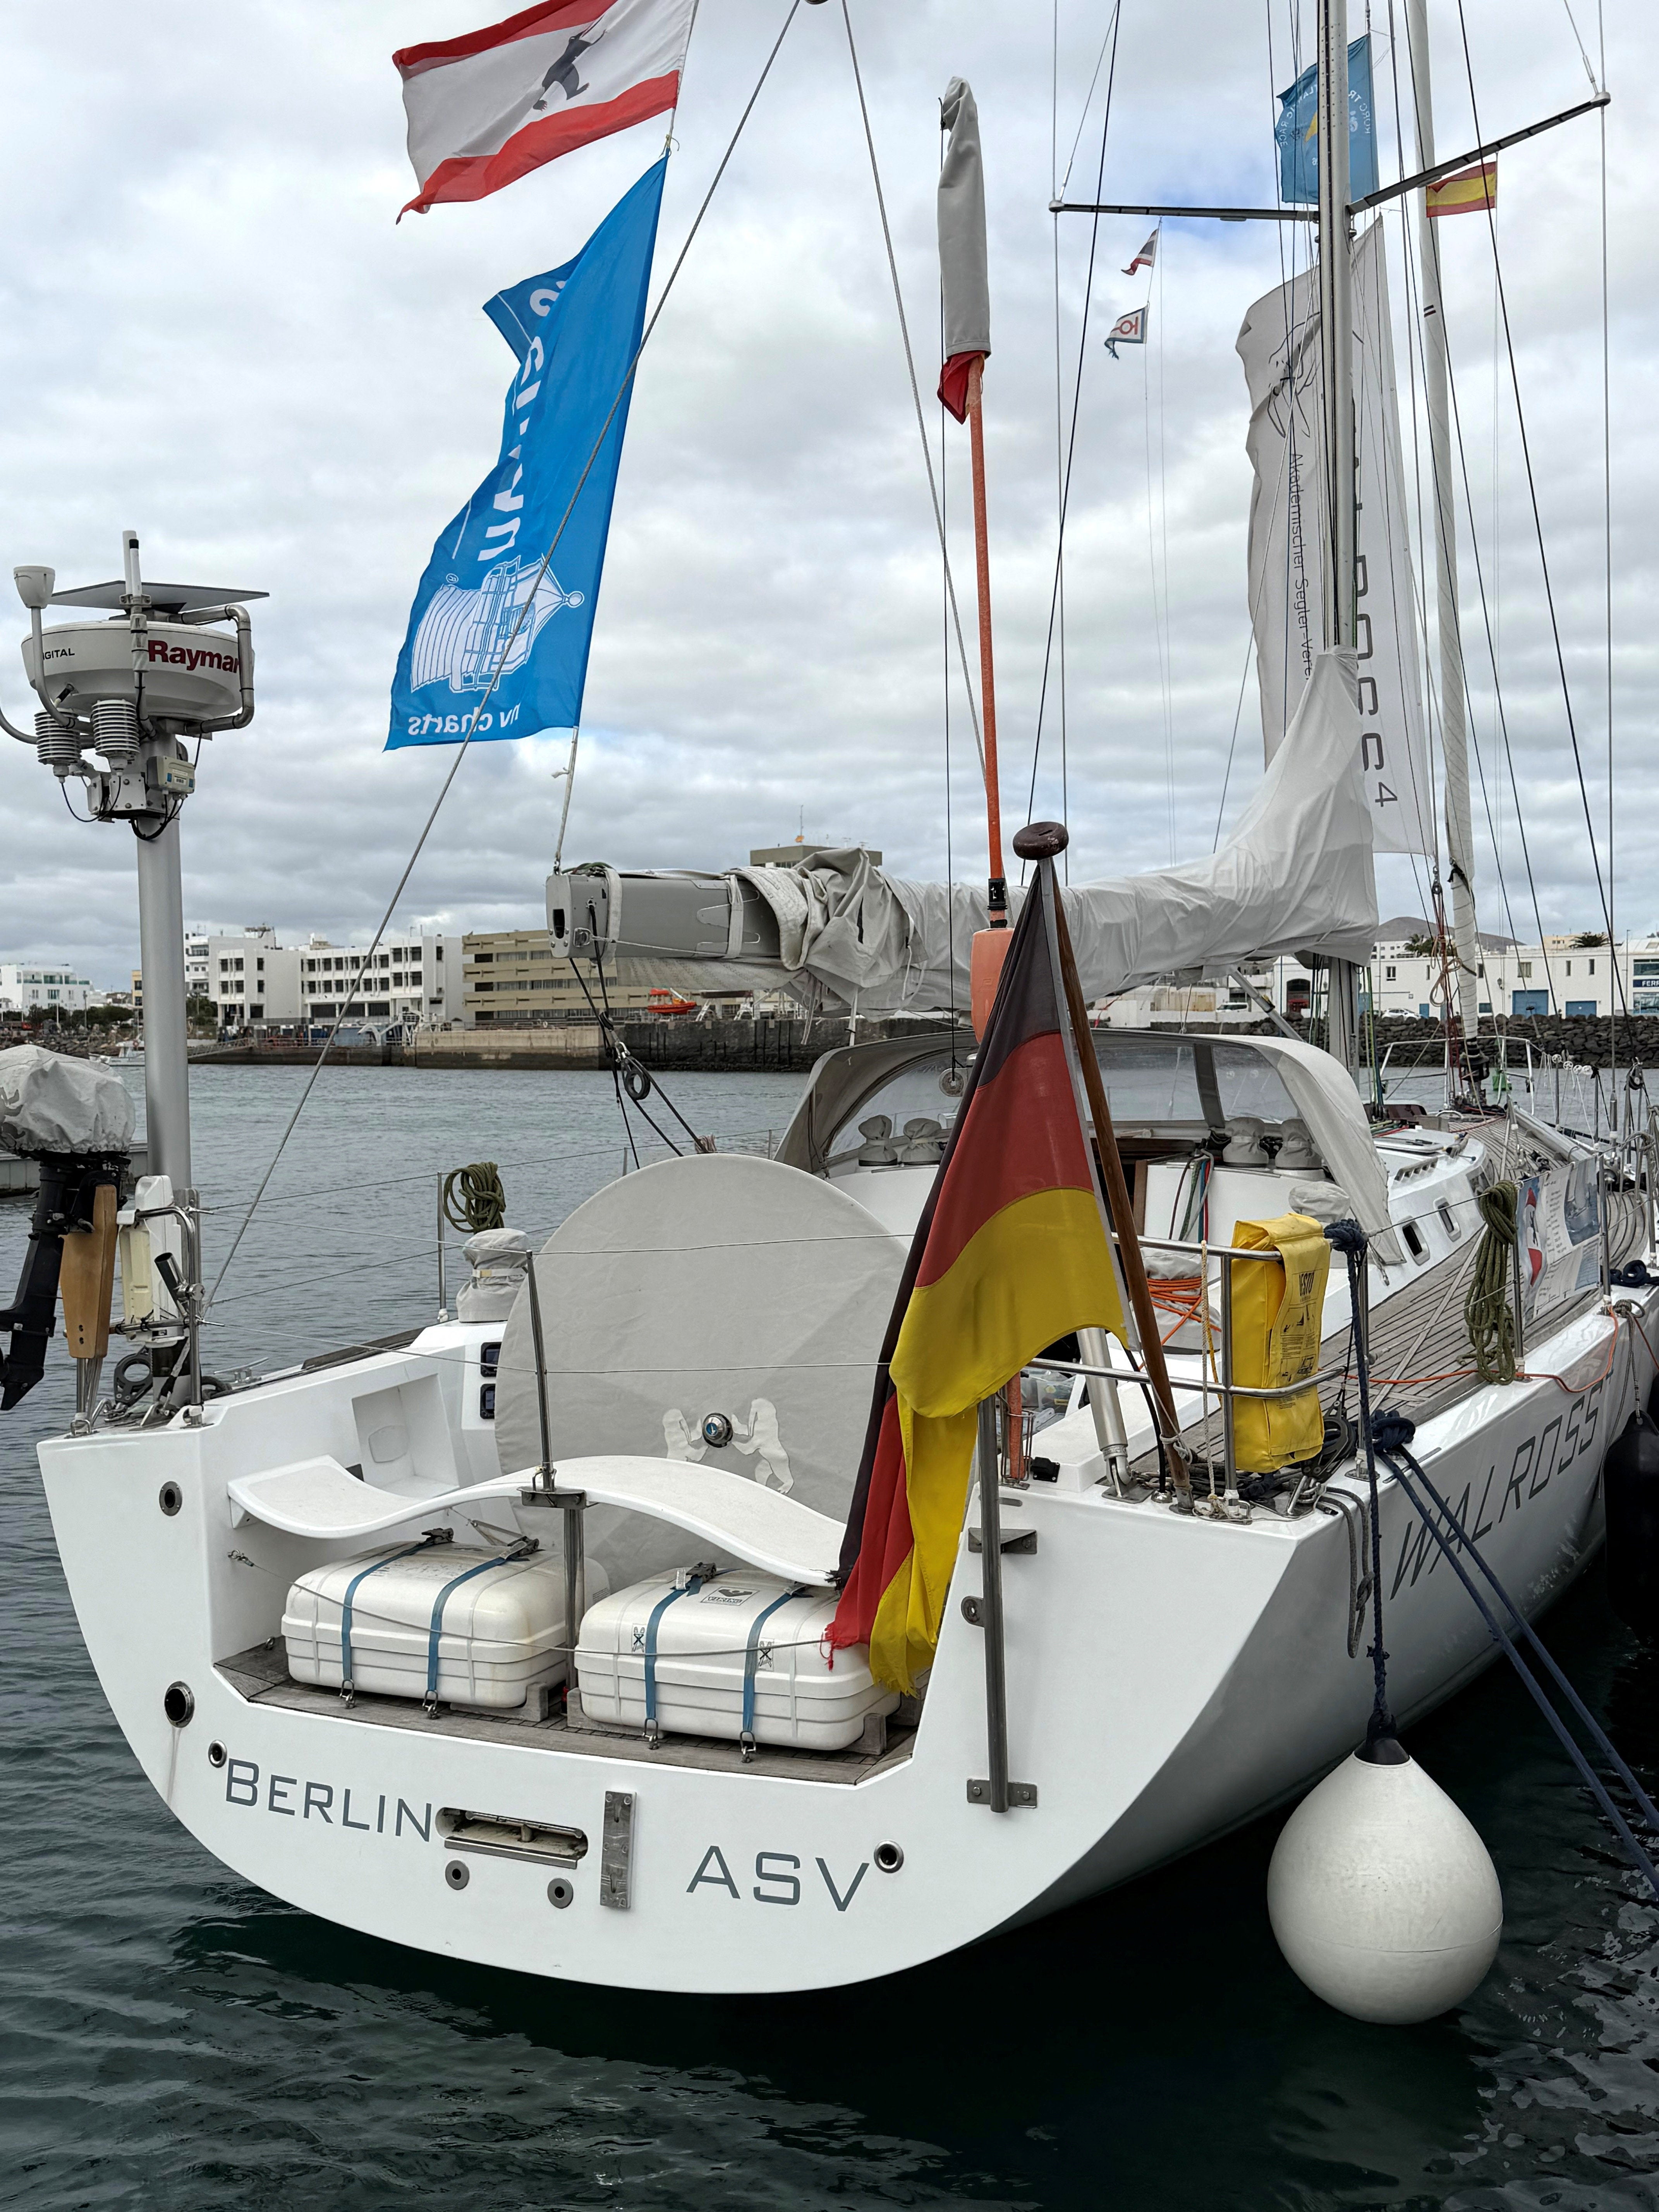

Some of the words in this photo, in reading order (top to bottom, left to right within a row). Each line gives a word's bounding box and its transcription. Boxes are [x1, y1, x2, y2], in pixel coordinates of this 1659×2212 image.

[1290, 453, 1306, 568] Akademischer
[43, 648, 75, 660] IGITAL
[148, 640, 240, 673] Raymar
[1295, 579, 1313, 680] Segler-Vere
[1375, 782, 1398, 807] 4
[1389, 1379, 1603, 1600] WALROSS
[226, 1758, 432, 1842] BERLIN
[686, 1845, 869, 1911] ASV
